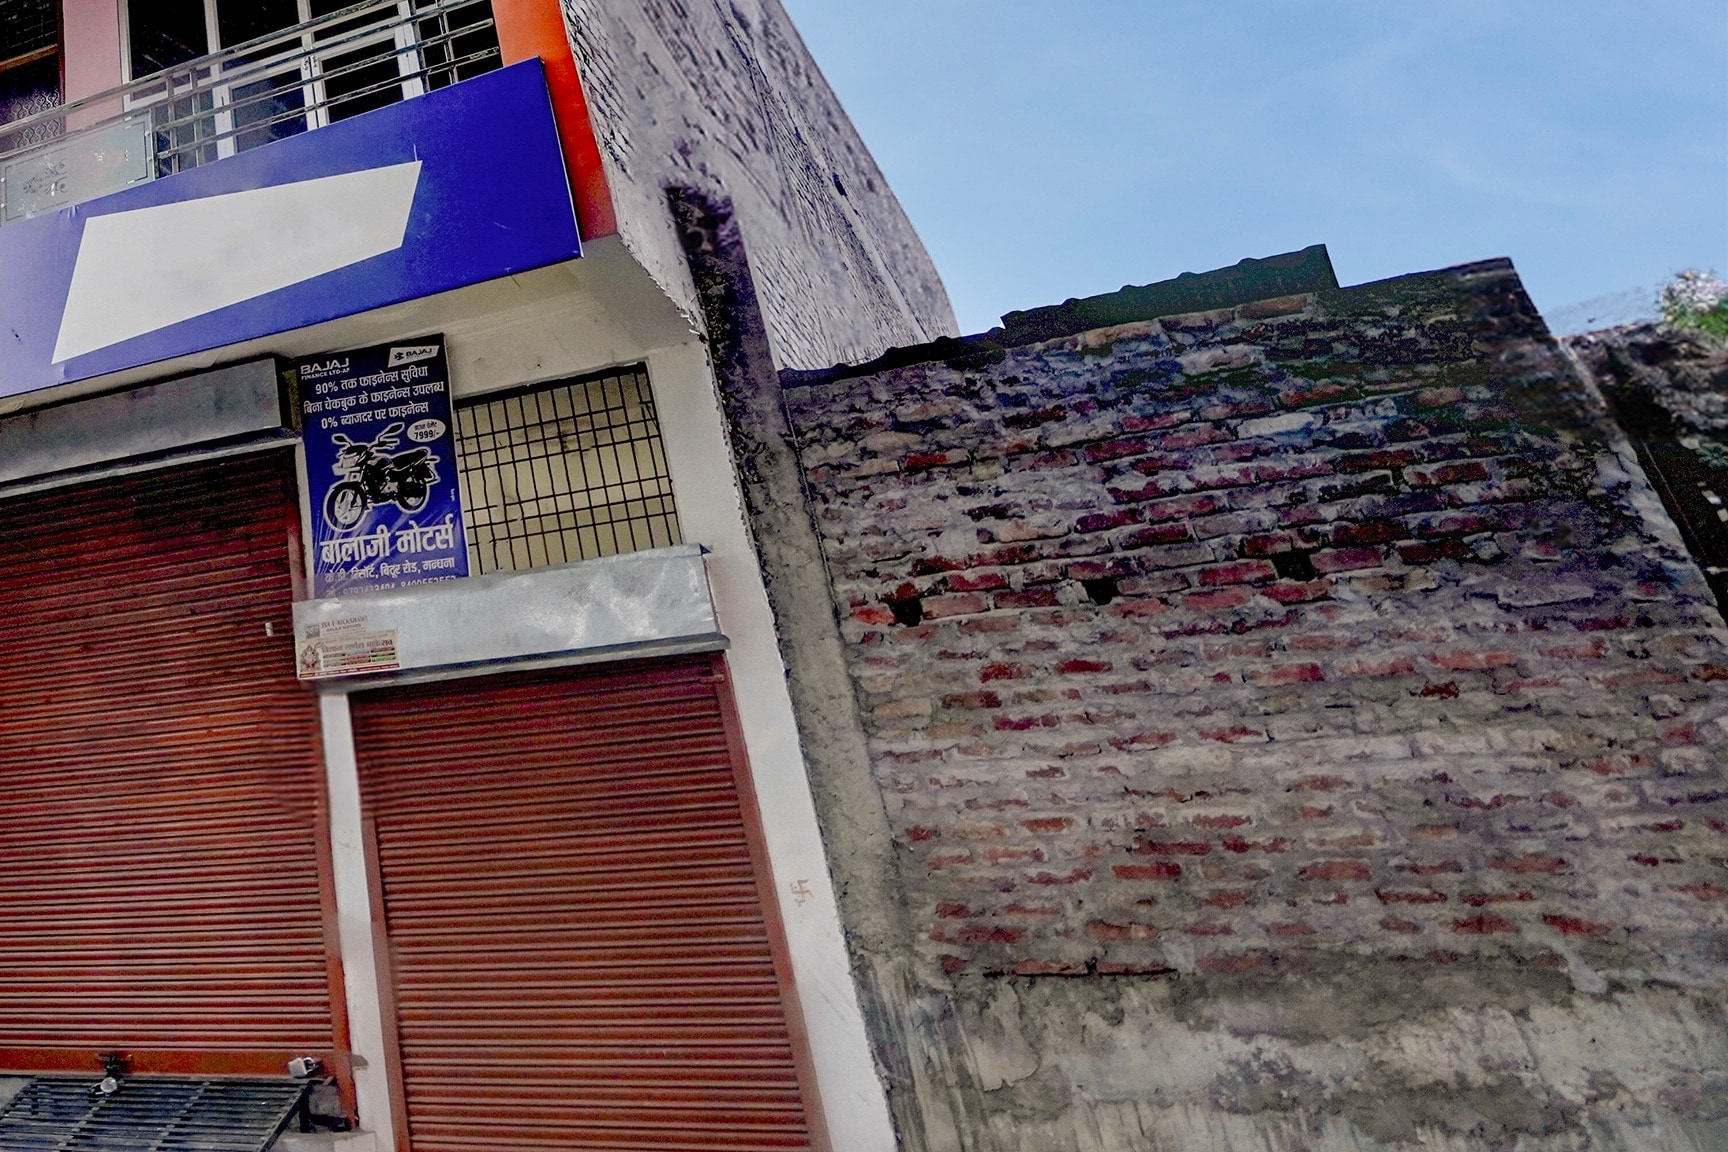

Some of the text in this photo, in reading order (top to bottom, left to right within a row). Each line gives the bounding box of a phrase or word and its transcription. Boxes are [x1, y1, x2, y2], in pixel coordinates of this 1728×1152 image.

[405, 347, 433, 357] BAJAJ
[300, 357, 350, 375] BAJAJ
[301, 371, 328, 380] FINANCE
[315, 380, 339, 395] 90%
[340, 379, 357, 391] तक
[400, 364, 428, 383] सुविधा
[303, 400, 323, 414] बिना
[324, 396, 357, 411] चेकबुक
[358, 391, 368, 405] के
[412, 381, 445, 396] उपलब्ध
[321, 416, 338, 429] 0%
[374, 409, 386, 420] पर
[414, 429, 439, 440] 7999/-
[319, 513, 454, 564] बालाजी मोटर्स
